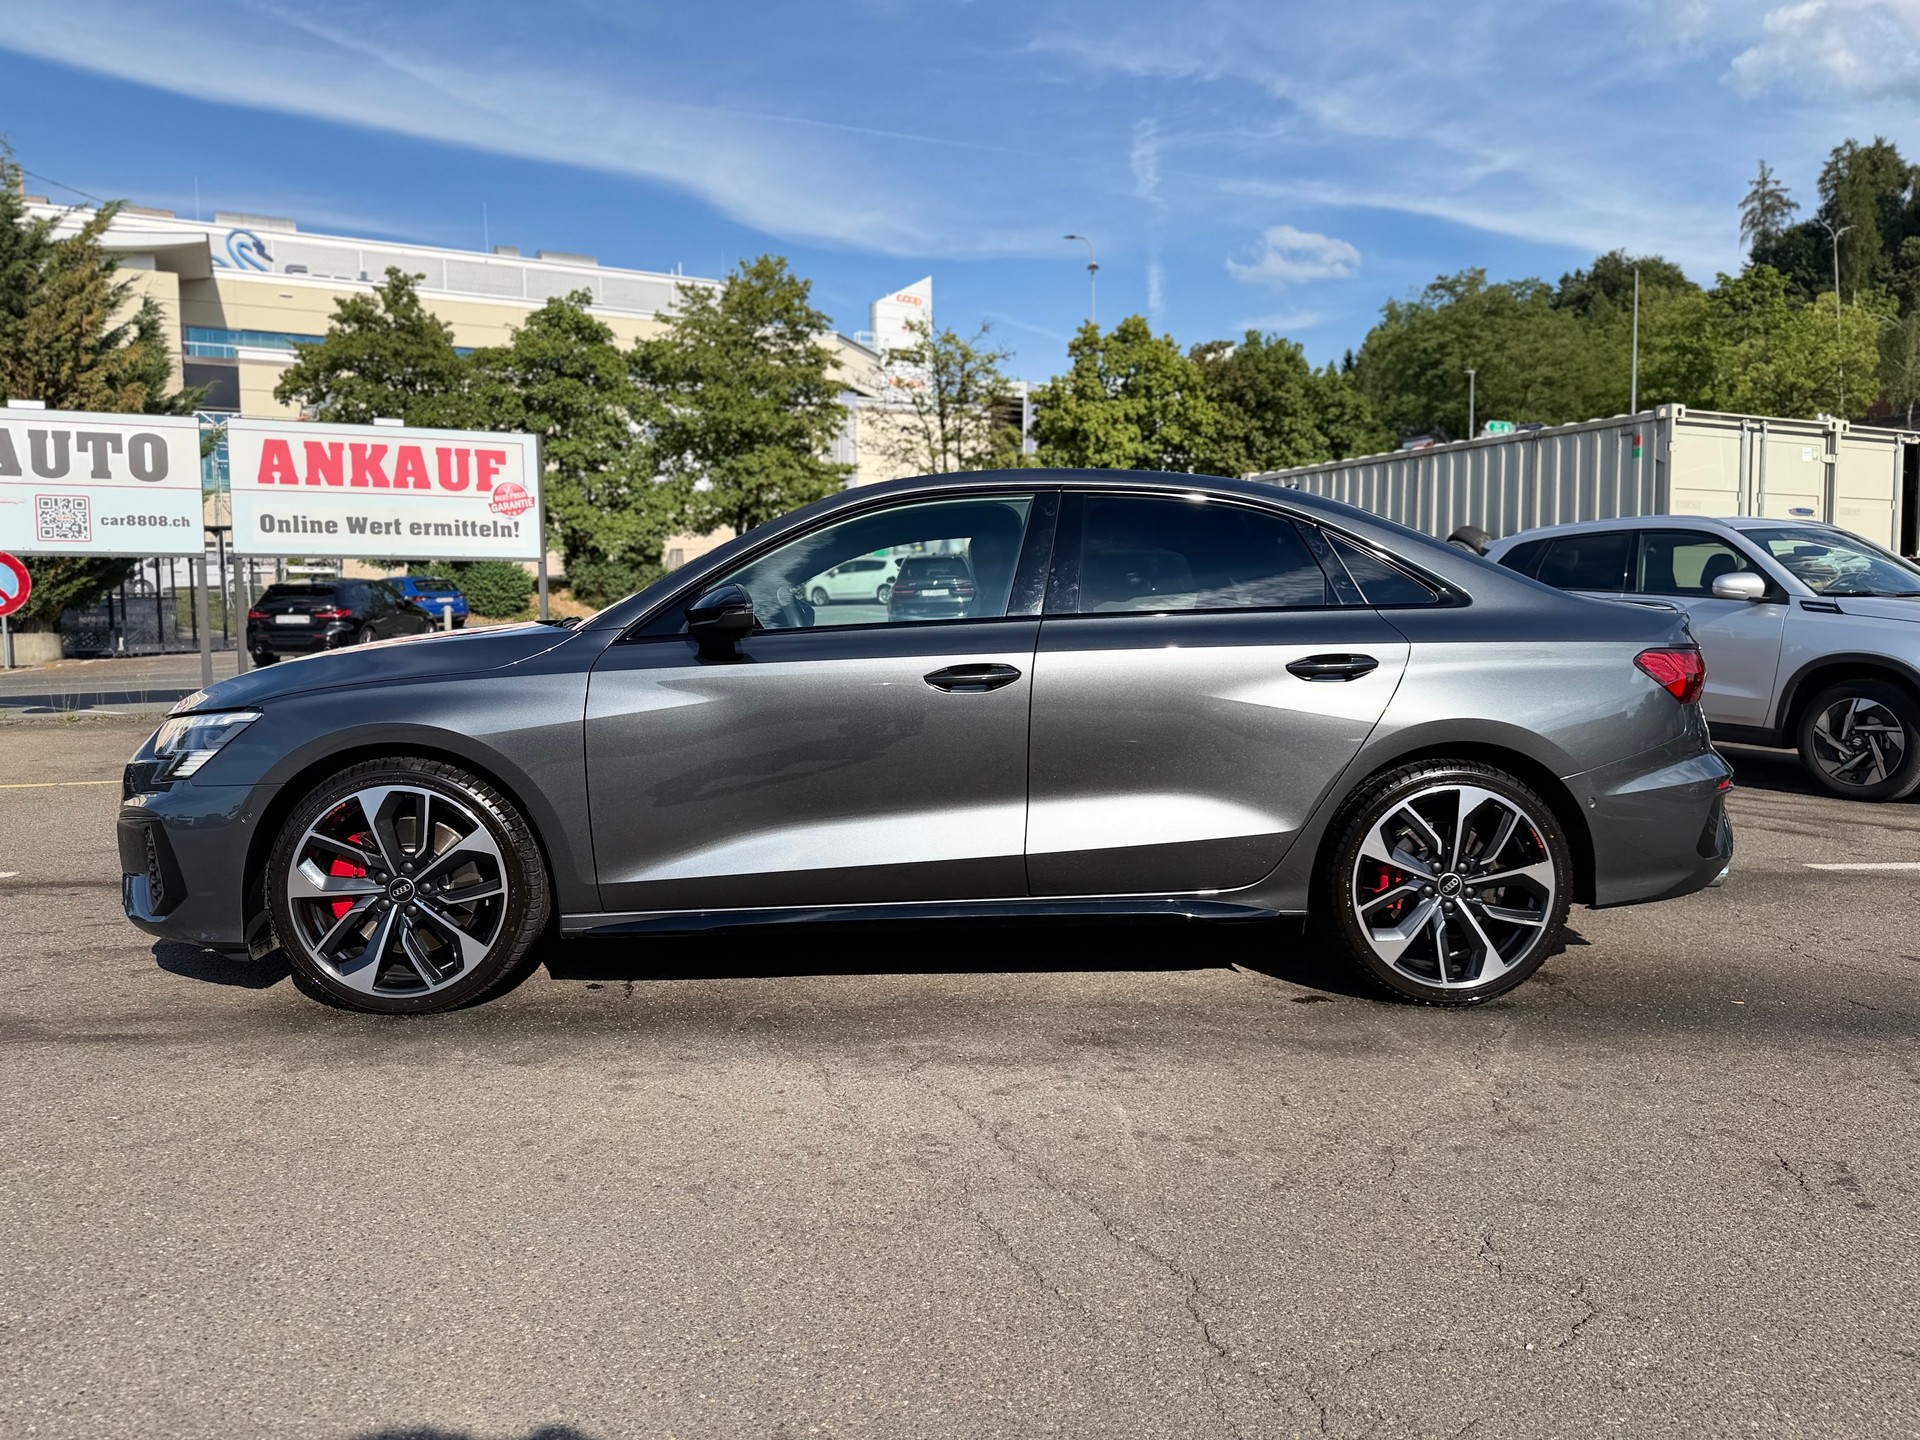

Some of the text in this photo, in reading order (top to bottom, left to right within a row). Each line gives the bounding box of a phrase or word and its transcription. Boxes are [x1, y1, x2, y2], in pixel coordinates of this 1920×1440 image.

[257, 439, 506, 492] ANKAUF
[491, 497, 534, 512] GARANTIE
[100, 515, 190, 528] car8808.ch
[260, 513, 520, 538] Online Wert ermitteln!
